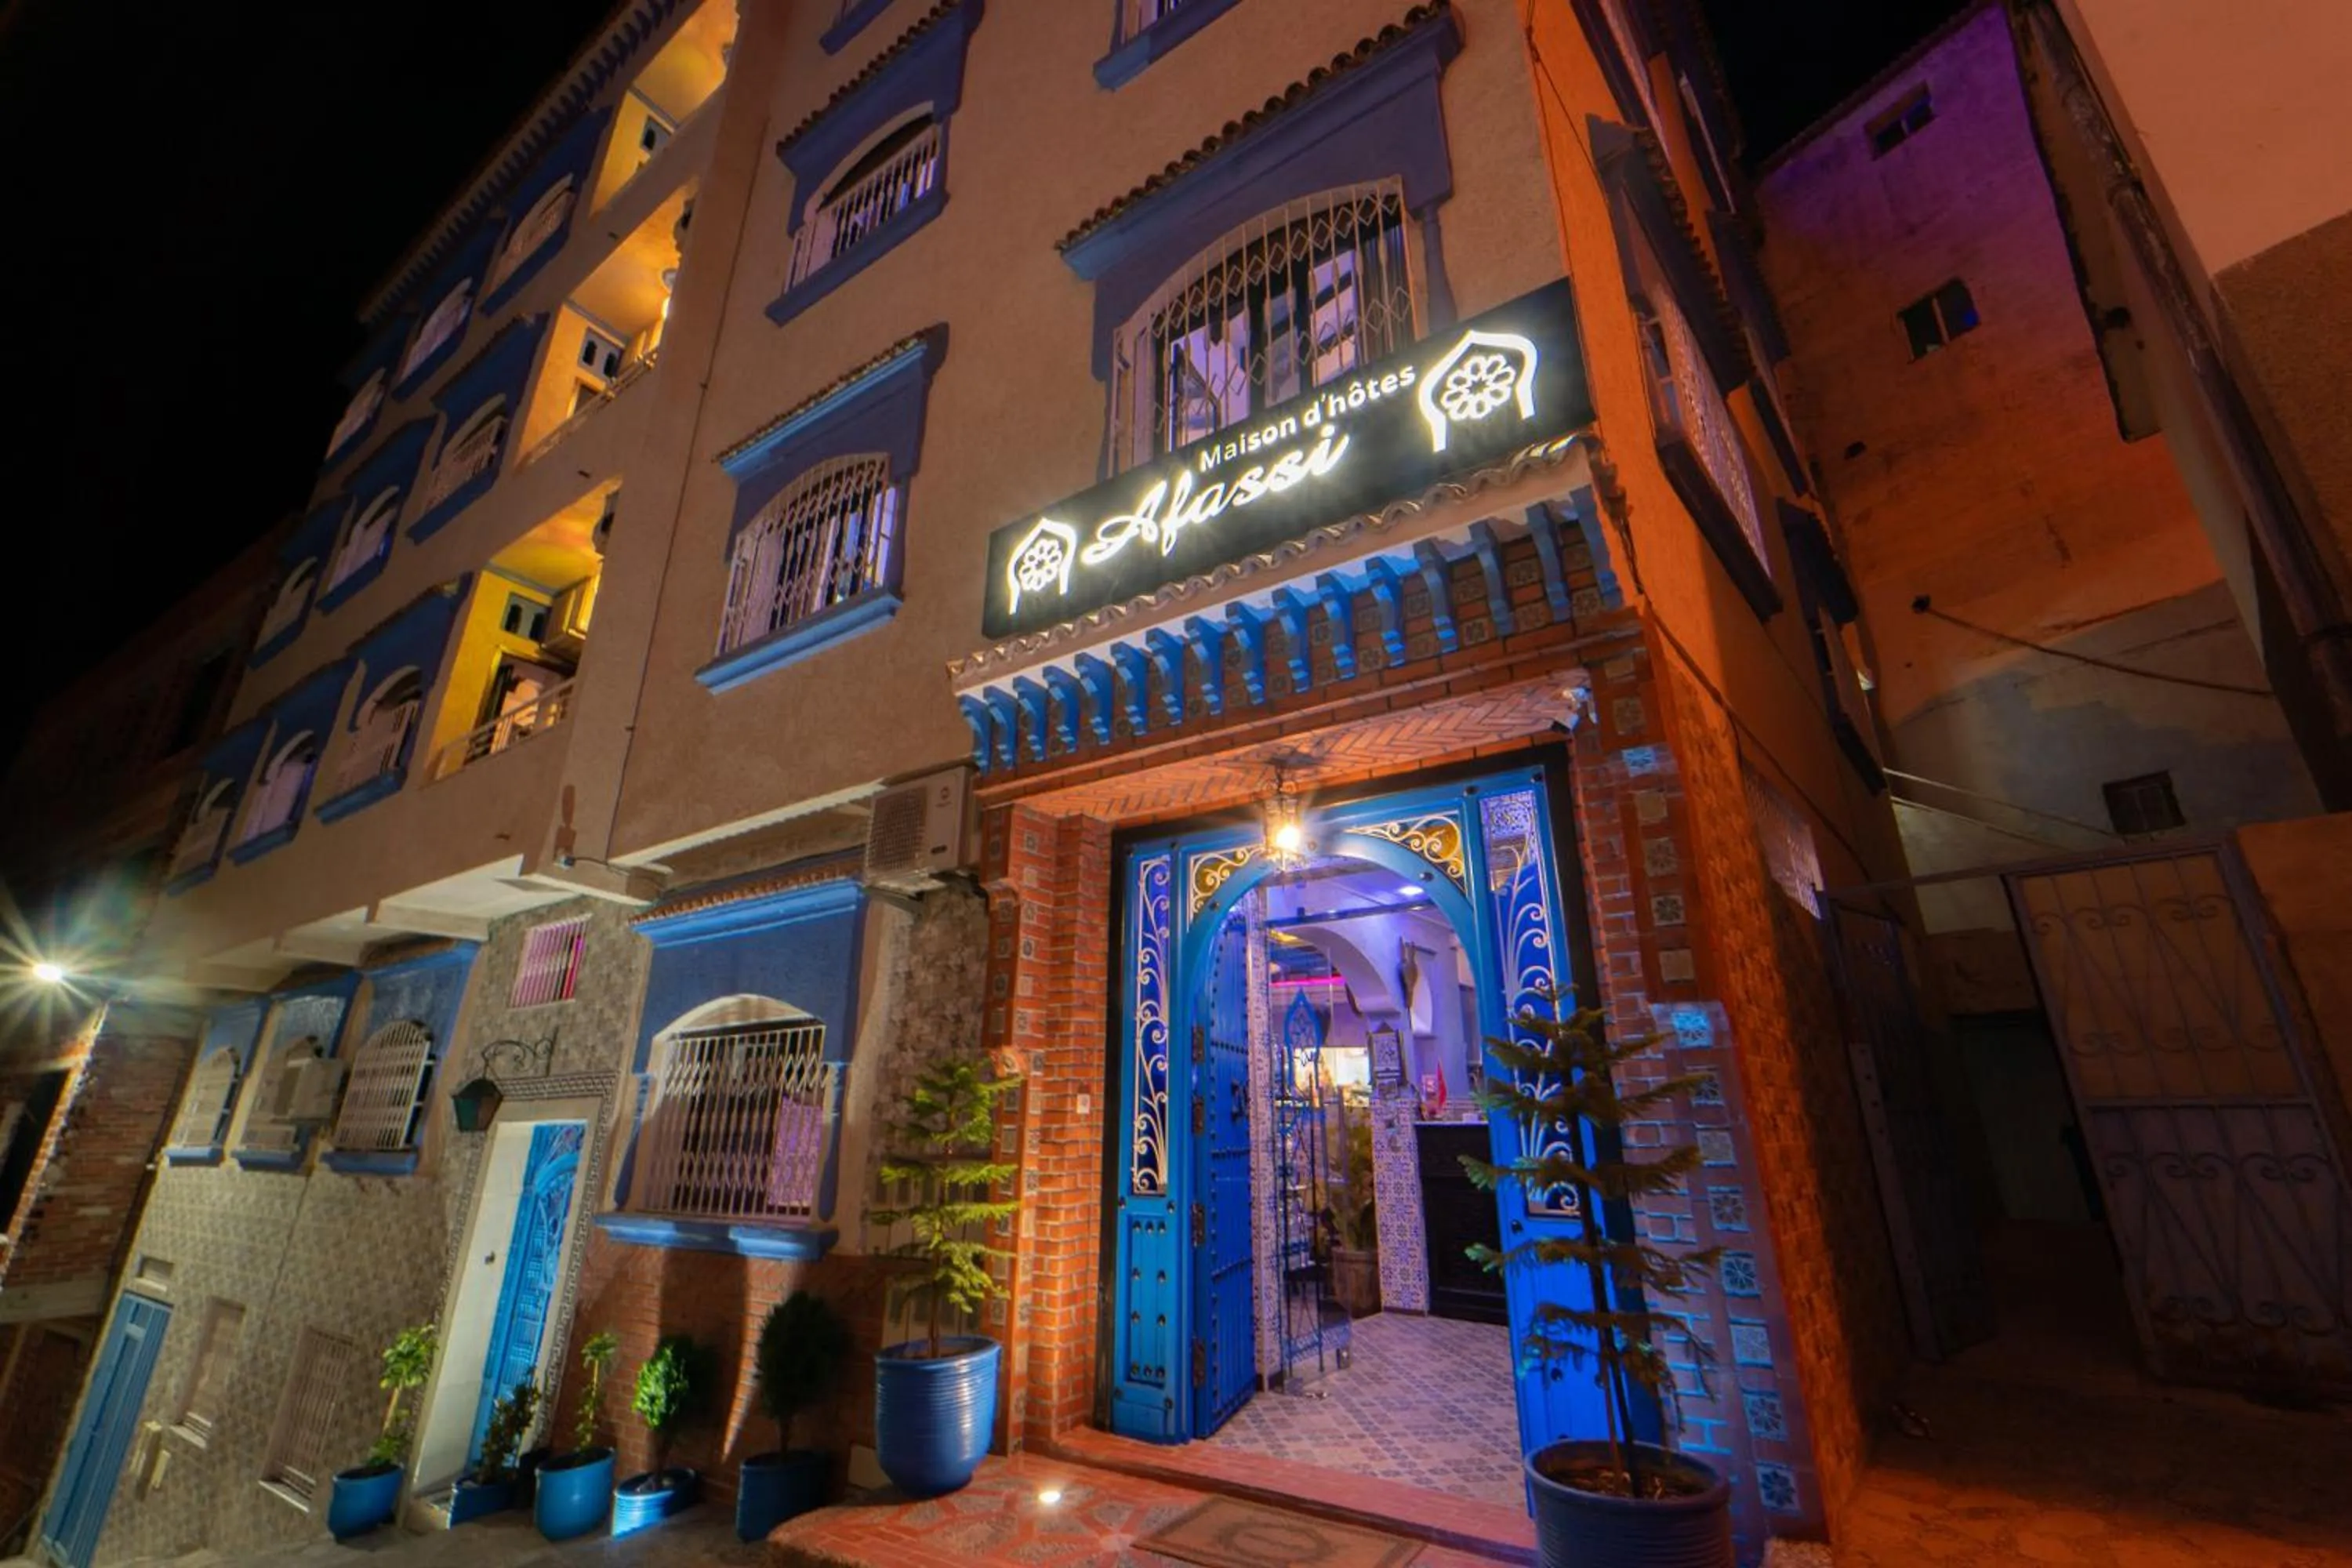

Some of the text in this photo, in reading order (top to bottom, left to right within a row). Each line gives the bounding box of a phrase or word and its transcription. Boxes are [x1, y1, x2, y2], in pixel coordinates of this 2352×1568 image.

[1199, 364, 1417, 473] Maison d'hôtes
[1080, 424, 1350, 564] Afassi
